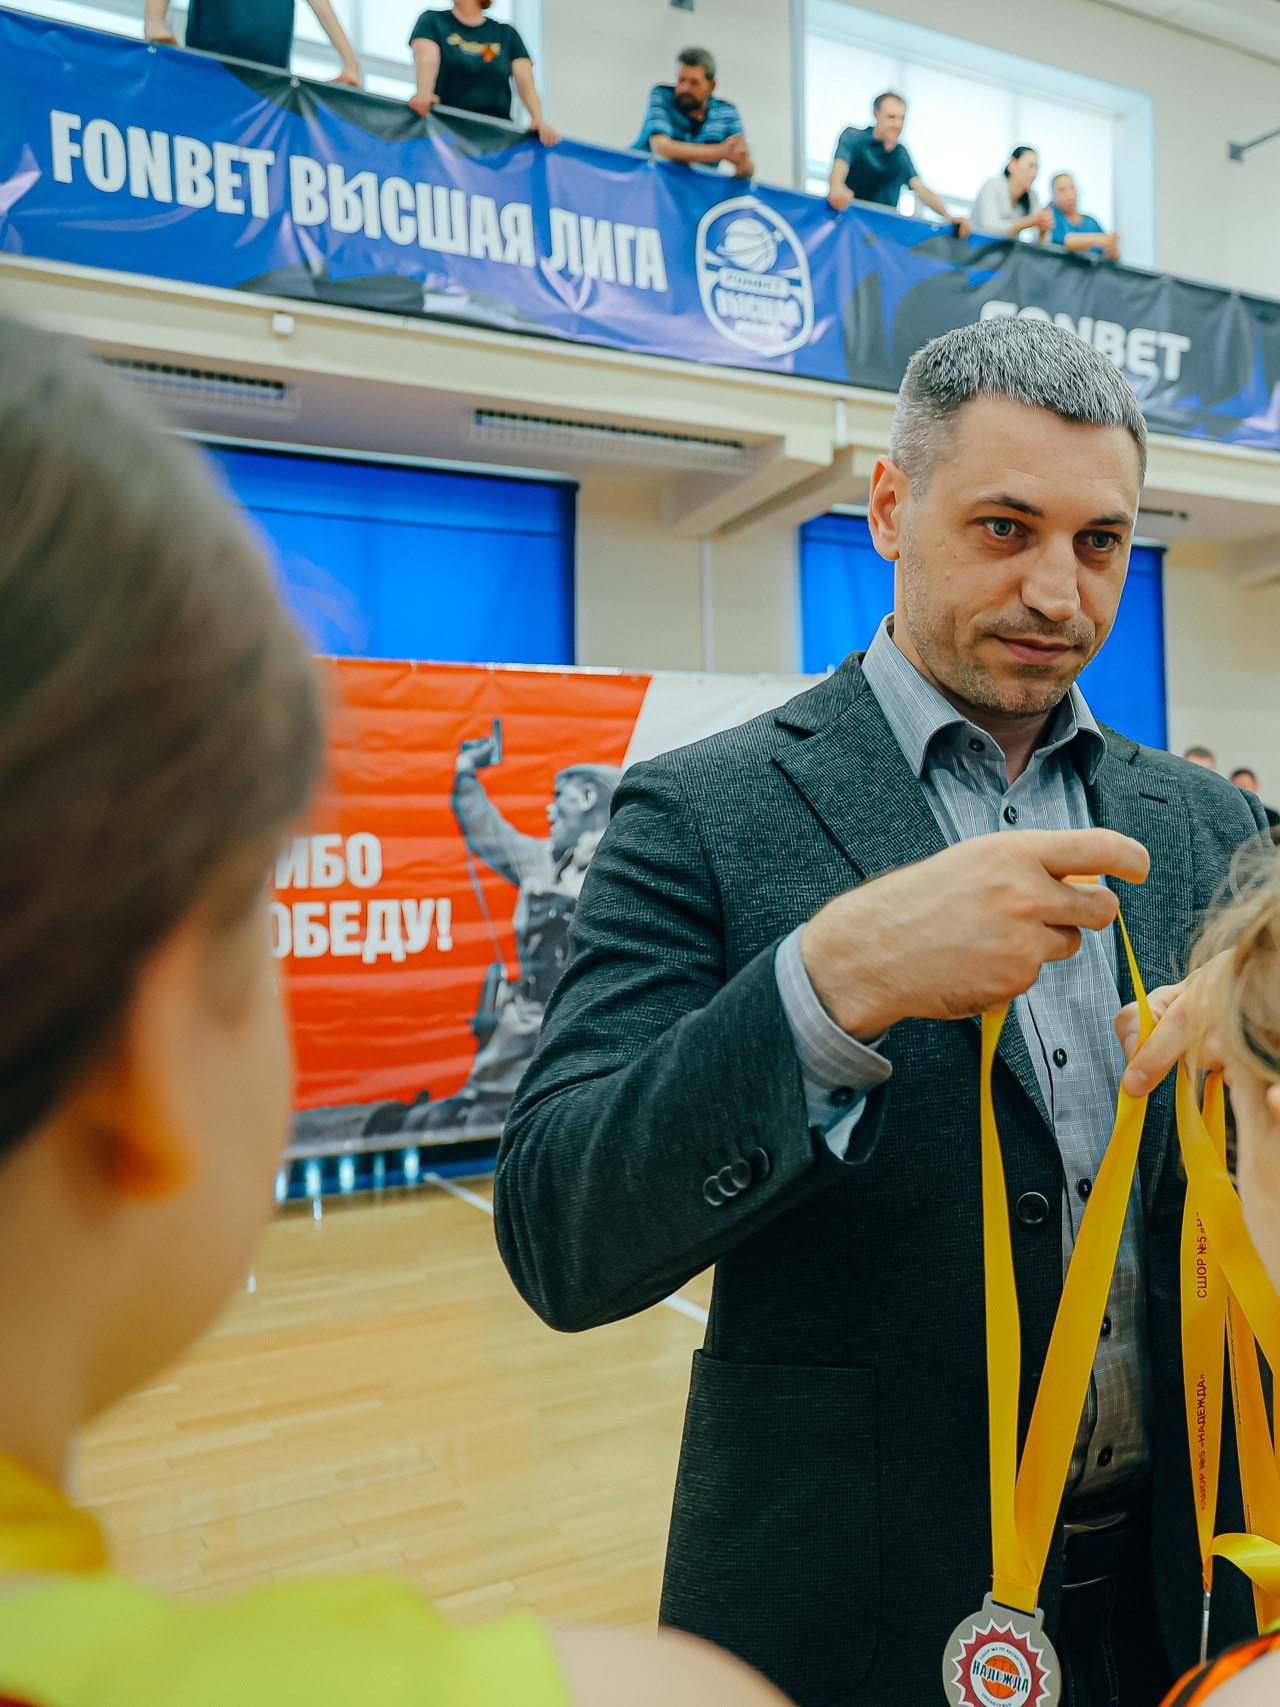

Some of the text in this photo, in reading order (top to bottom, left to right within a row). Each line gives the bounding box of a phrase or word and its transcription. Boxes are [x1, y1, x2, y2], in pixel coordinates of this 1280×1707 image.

[50, 109, 669, 293] FONBET ВЫСШАЯ ЛИГА
[979, 299, 1192, 382] NBET
[274, 832, 383, 890] ИБО
[270, 898, 453, 964] ОБЕДУ!
[1195, 1236, 1208, 1255] №5
[1196, 1259, 1208, 1299] СШОР
[1195, 1373, 1207, 1449] «НАДЕЖДА»
[1197, 1473, 1207, 1511] СШОР
[972, 1659, 1029, 1693] НАДЕЖДА
